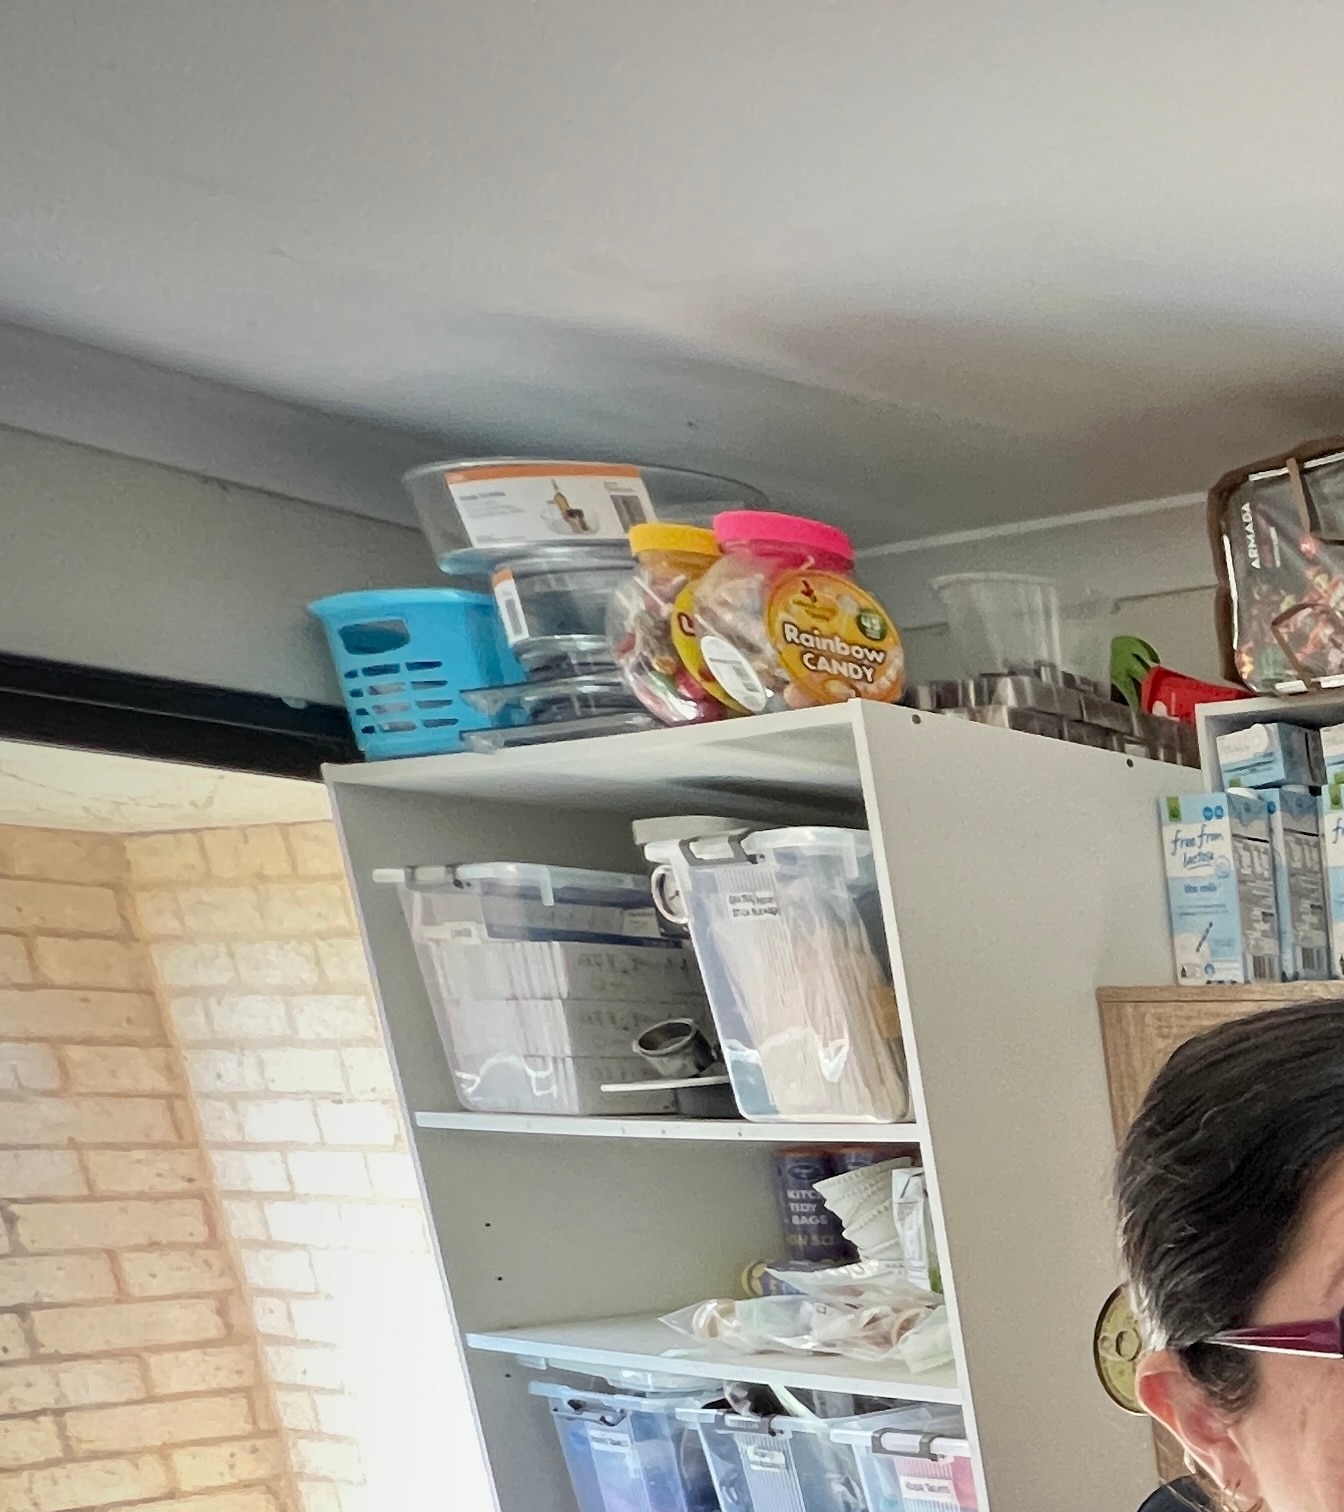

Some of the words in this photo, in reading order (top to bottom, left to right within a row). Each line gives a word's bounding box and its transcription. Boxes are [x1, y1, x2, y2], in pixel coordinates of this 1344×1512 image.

[1241, 502, 1260, 569] ARMADA
[783, 622, 885, 665] Rainbow
[802, 653, 876, 684] CANDY
[787, 1189, 823, 1199] KITC
[789, 1203, 817, 1212] TIDY
[791, 1215, 828, 1225] BAGS
